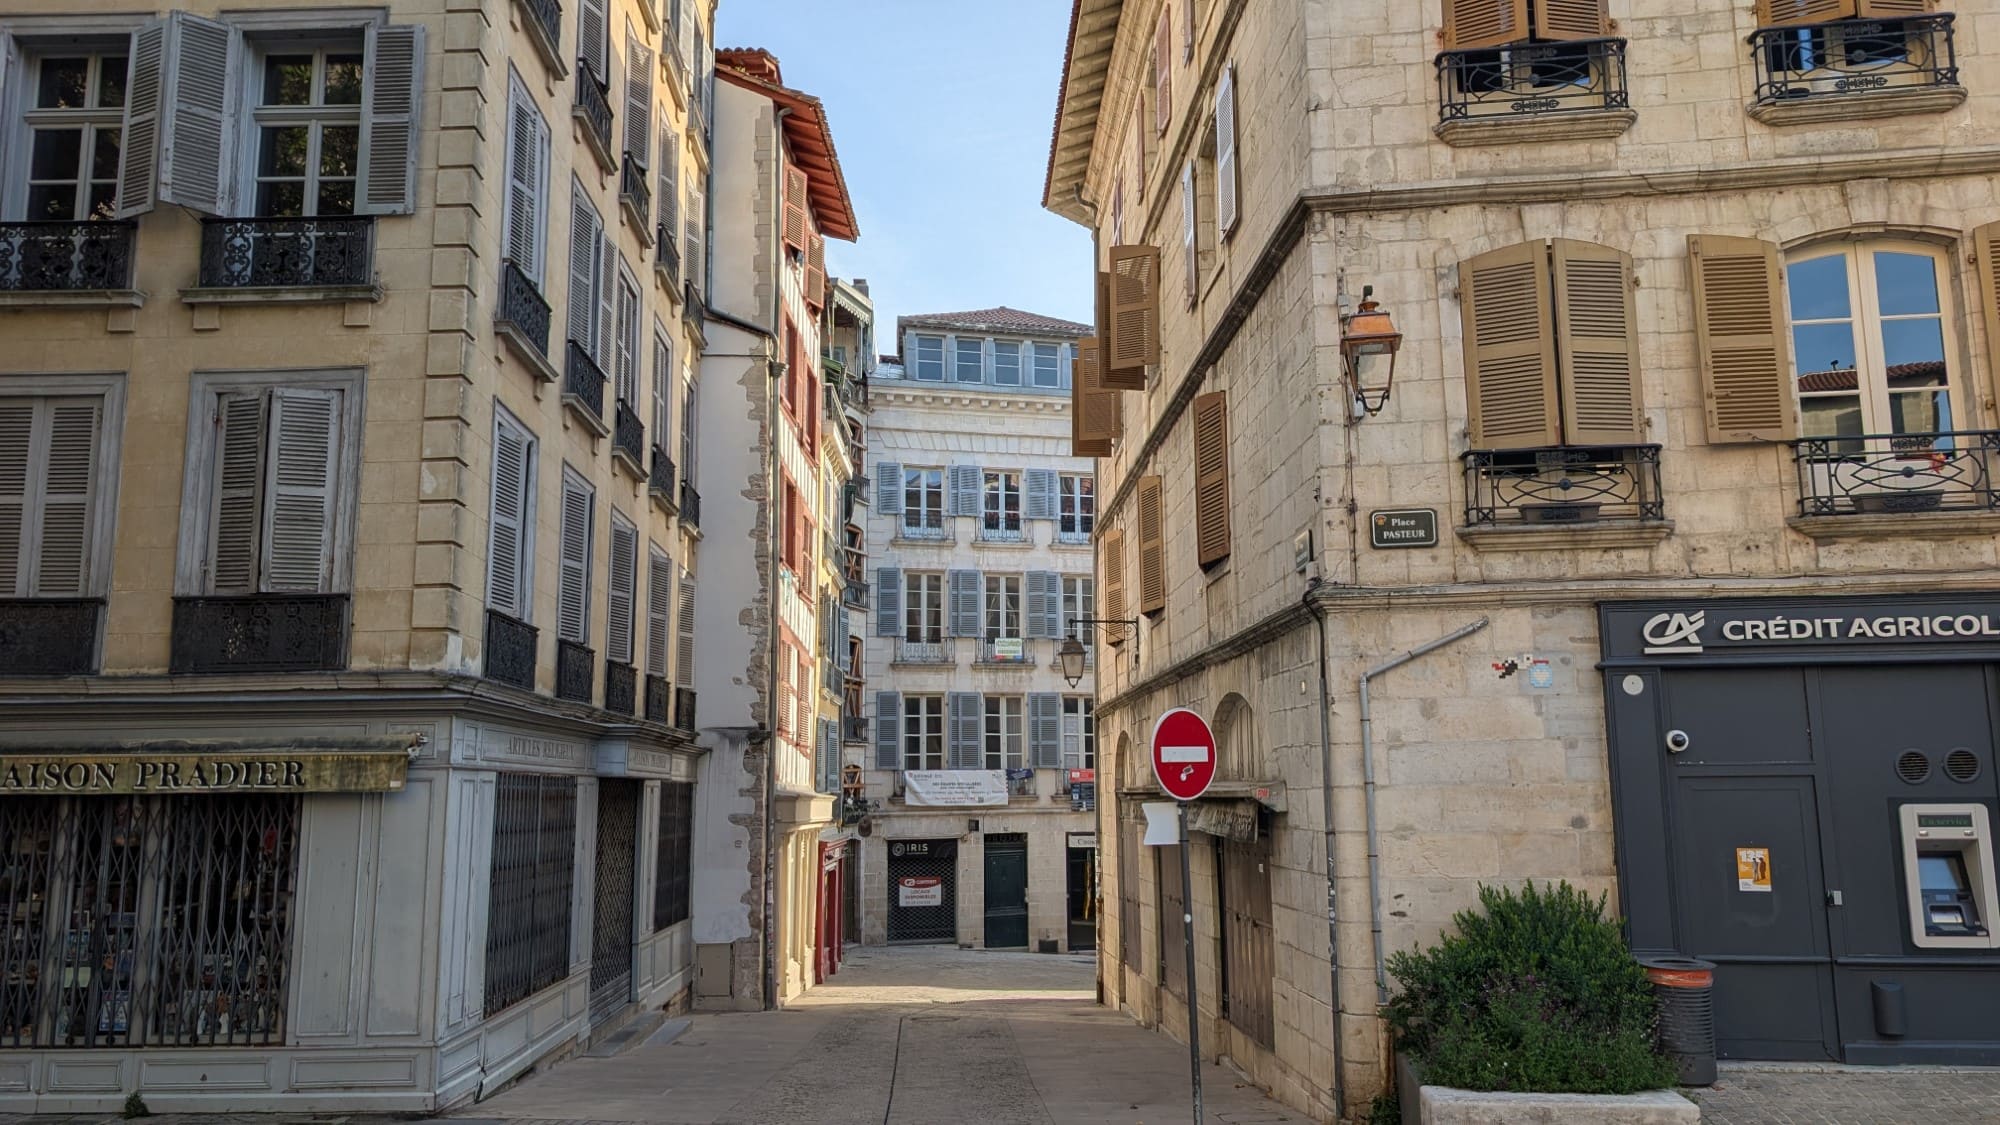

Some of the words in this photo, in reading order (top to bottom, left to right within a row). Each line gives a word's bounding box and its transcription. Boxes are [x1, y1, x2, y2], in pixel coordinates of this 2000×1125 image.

[1391, 518, 1415, 526] Place
[1384, 530, 1425, 539] PASTEUR
[1722, 615, 1844, 641] CRÉDIT
[1848, 613, 2000, 638] AGRICOL
[0, 761, 119, 791] AISON
[133, 760, 306, 790] PRADIER
[906, 843, 929, 852] IRIS
